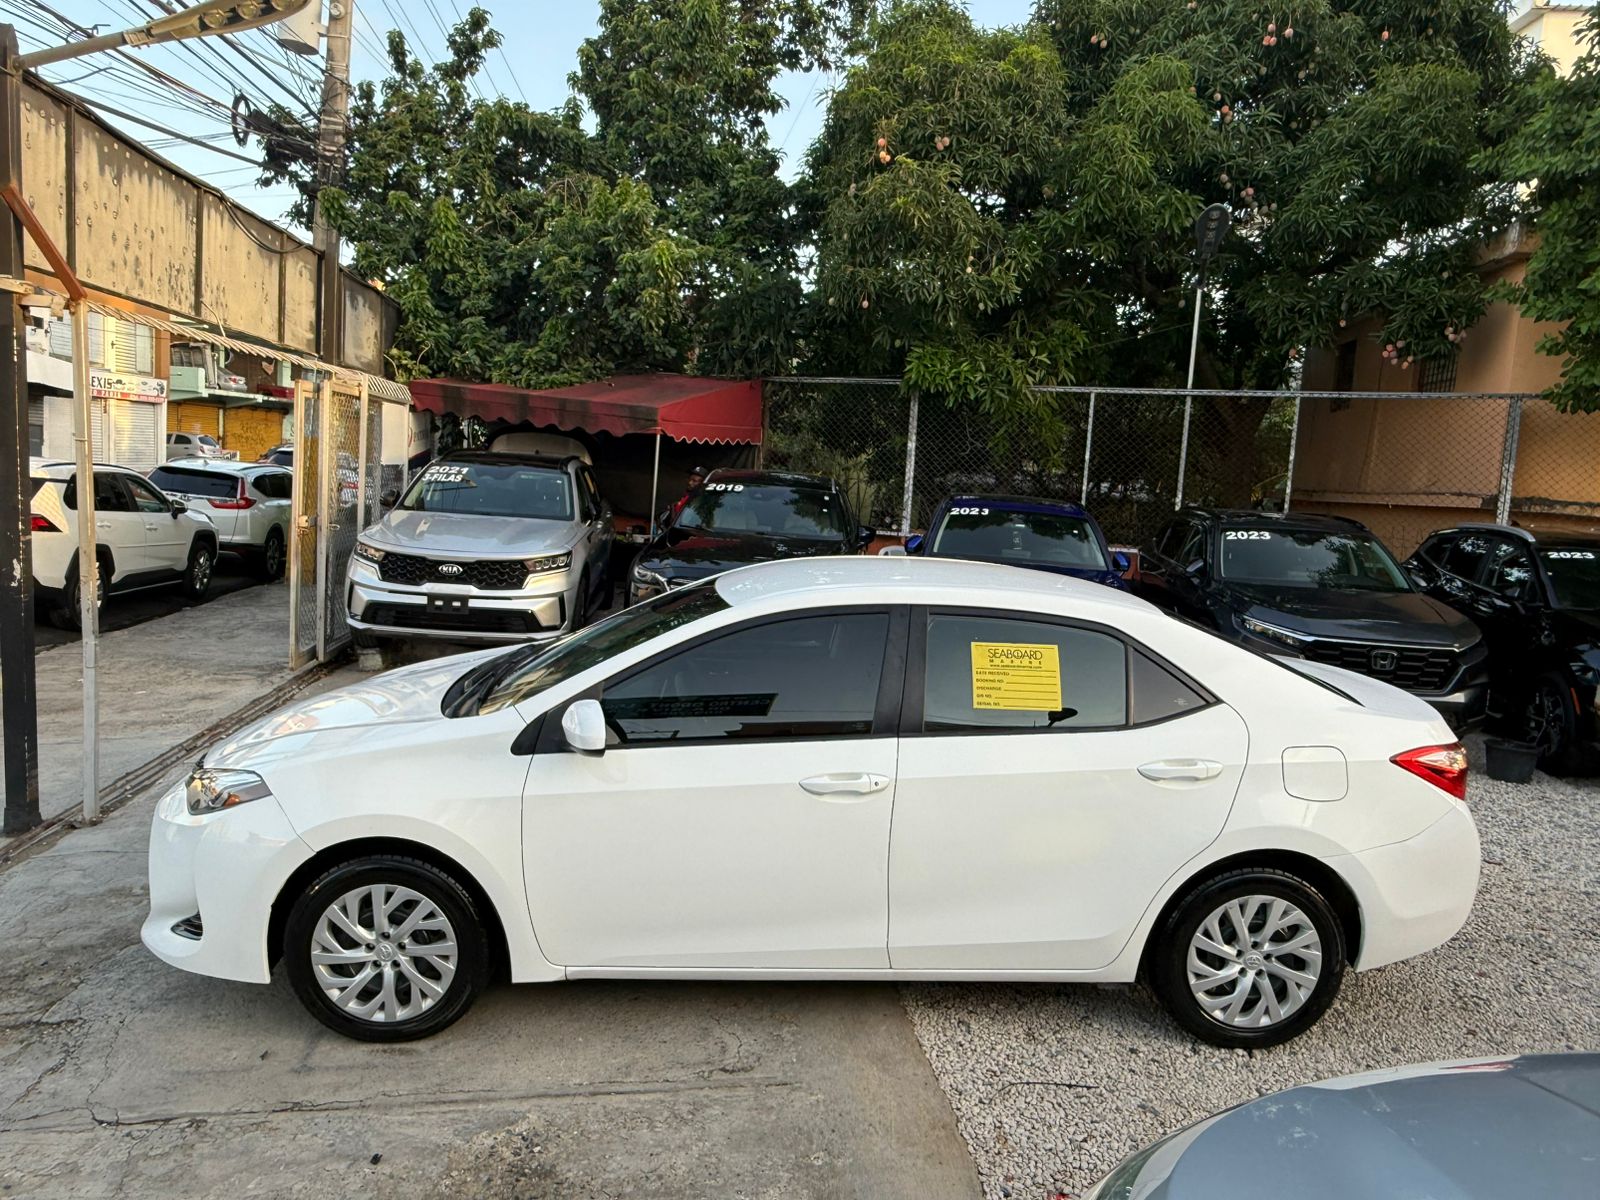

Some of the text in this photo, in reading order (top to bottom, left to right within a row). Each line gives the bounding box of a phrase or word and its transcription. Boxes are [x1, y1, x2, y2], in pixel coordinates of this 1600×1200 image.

[427, 465, 470, 474] 2021
[422, 473, 463, 482] 3-FILAS
[705, 483, 744, 492] 2019
[949, 507, 989, 515] 2023
[1225, 530, 1271, 540] 2023
[1547, 551, 1595, 559] 2023
[988, 648, 1043, 660] SEABOARD
